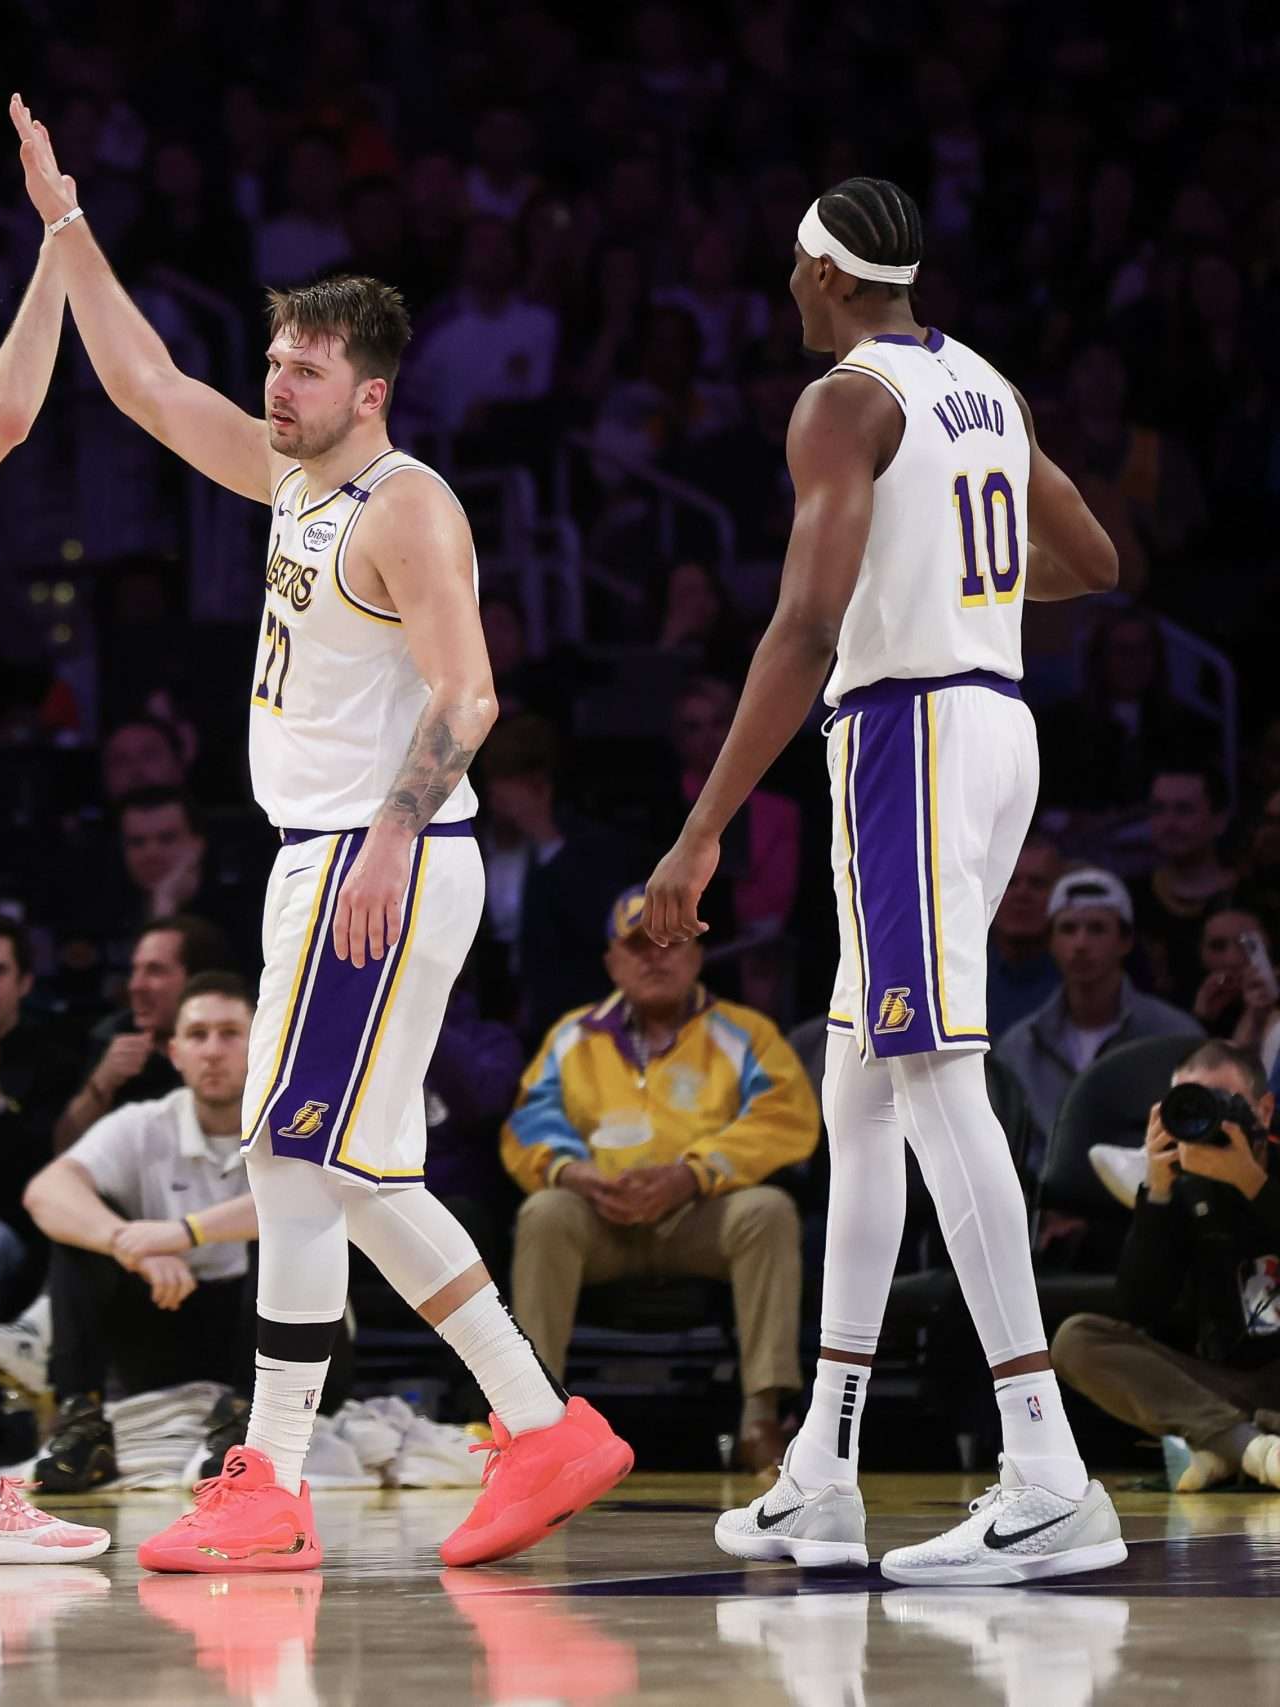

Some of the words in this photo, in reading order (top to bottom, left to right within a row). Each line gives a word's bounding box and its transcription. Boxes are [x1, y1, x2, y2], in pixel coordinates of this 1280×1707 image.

[932, 389, 1005, 443] KOLOKO
[952, 466, 1021, 608] 10
[251, 609, 292, 717] 77
